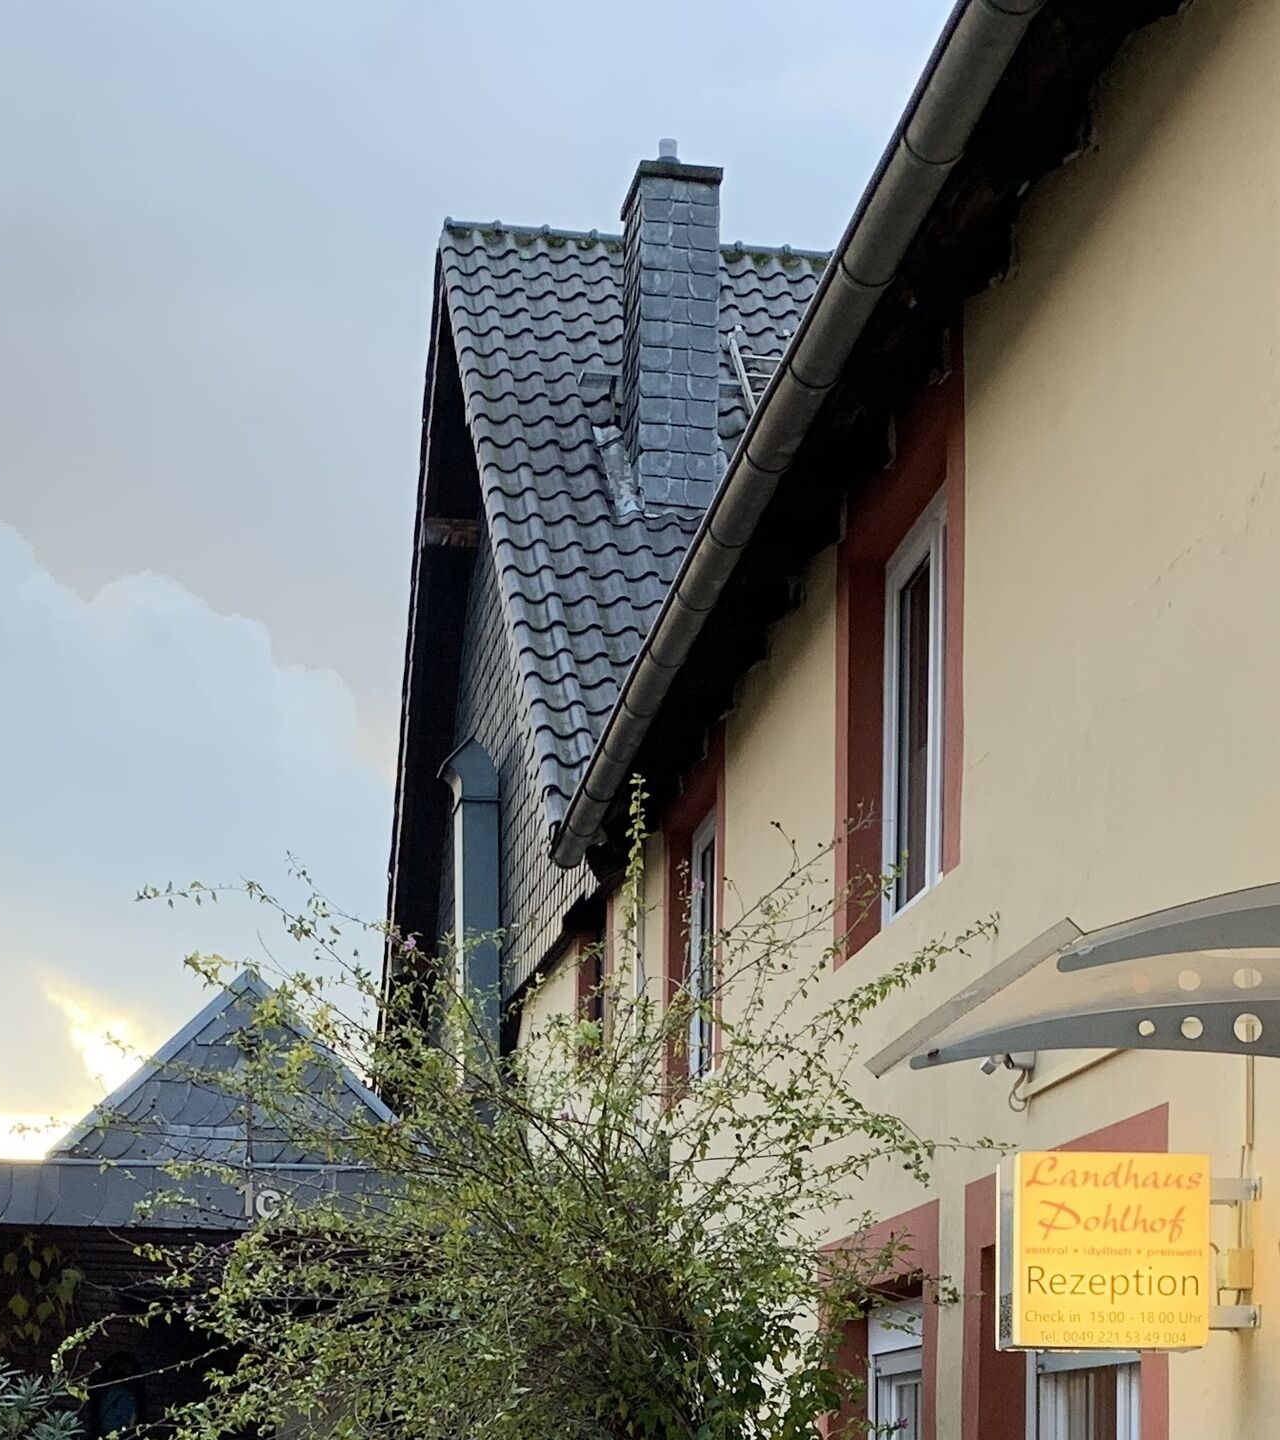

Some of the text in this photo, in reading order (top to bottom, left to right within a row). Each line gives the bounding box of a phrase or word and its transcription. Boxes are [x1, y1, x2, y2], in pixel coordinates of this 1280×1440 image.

[1025, 1156, 1203, 1190] Landhaus
[1147, 1248, 1203, 1257] preiswert
[1027, 1265, 1199, 1305] Rezeption
[1025, 1310, 1065, 1322] Check
[1069, 1310, 1081, 1322] in
[1179, 1312, 1202, 1324] Uhr
[1063, 1331, 1094, 1343] 0049
[1097, 1331, 1119, 1343] 221
[1125, 1332, 1140, 1343] 53
[1144, 1332, 1160, 1343] 49
[1164, 1332, 1187, 1344] 004
